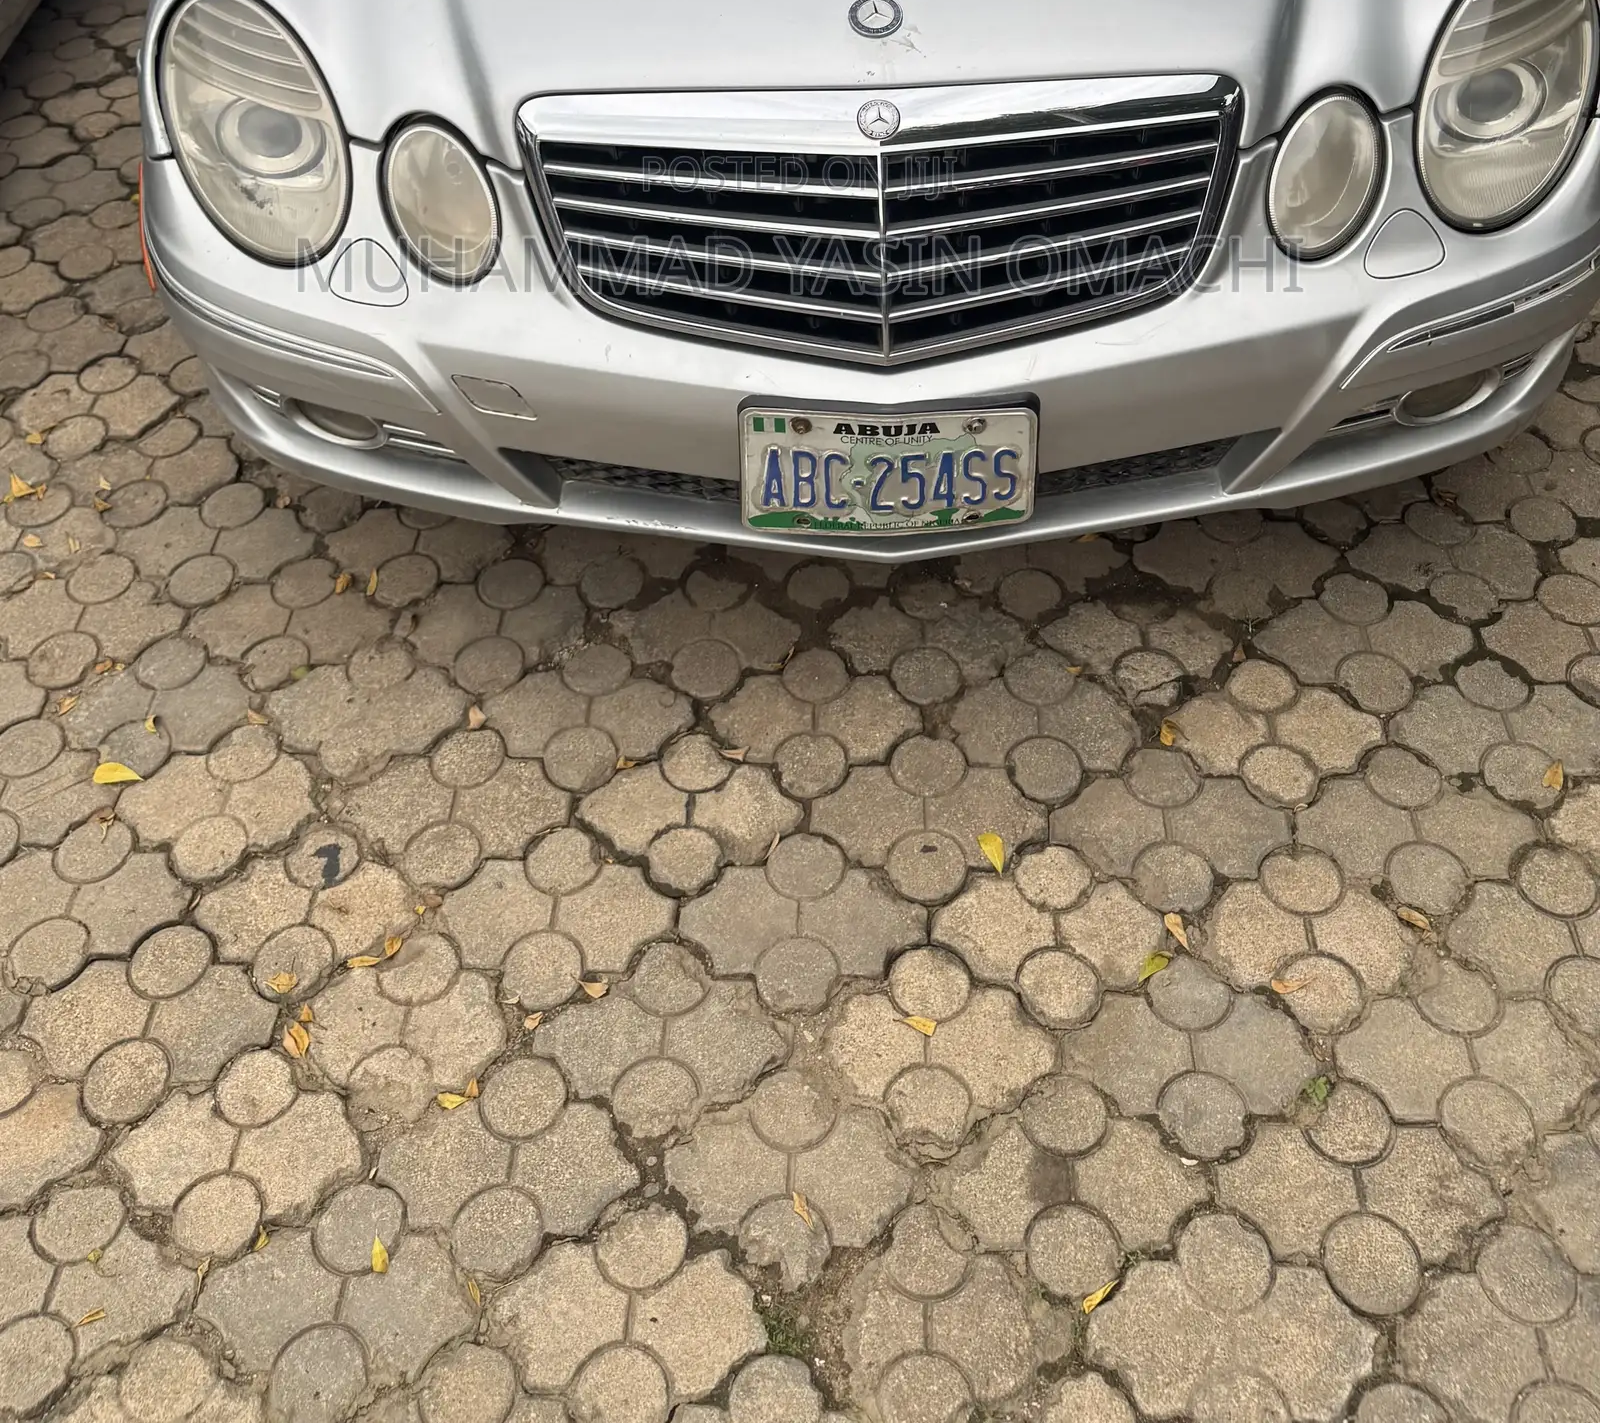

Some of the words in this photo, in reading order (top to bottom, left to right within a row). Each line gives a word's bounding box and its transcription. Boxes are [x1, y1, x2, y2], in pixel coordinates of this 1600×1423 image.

[833, 422, 940, 437] ABUJA
[840, 435, 881, 446] CENTRE
[885, 437, 901, 446] OF
[903, 435, 933, 445] UNITY
